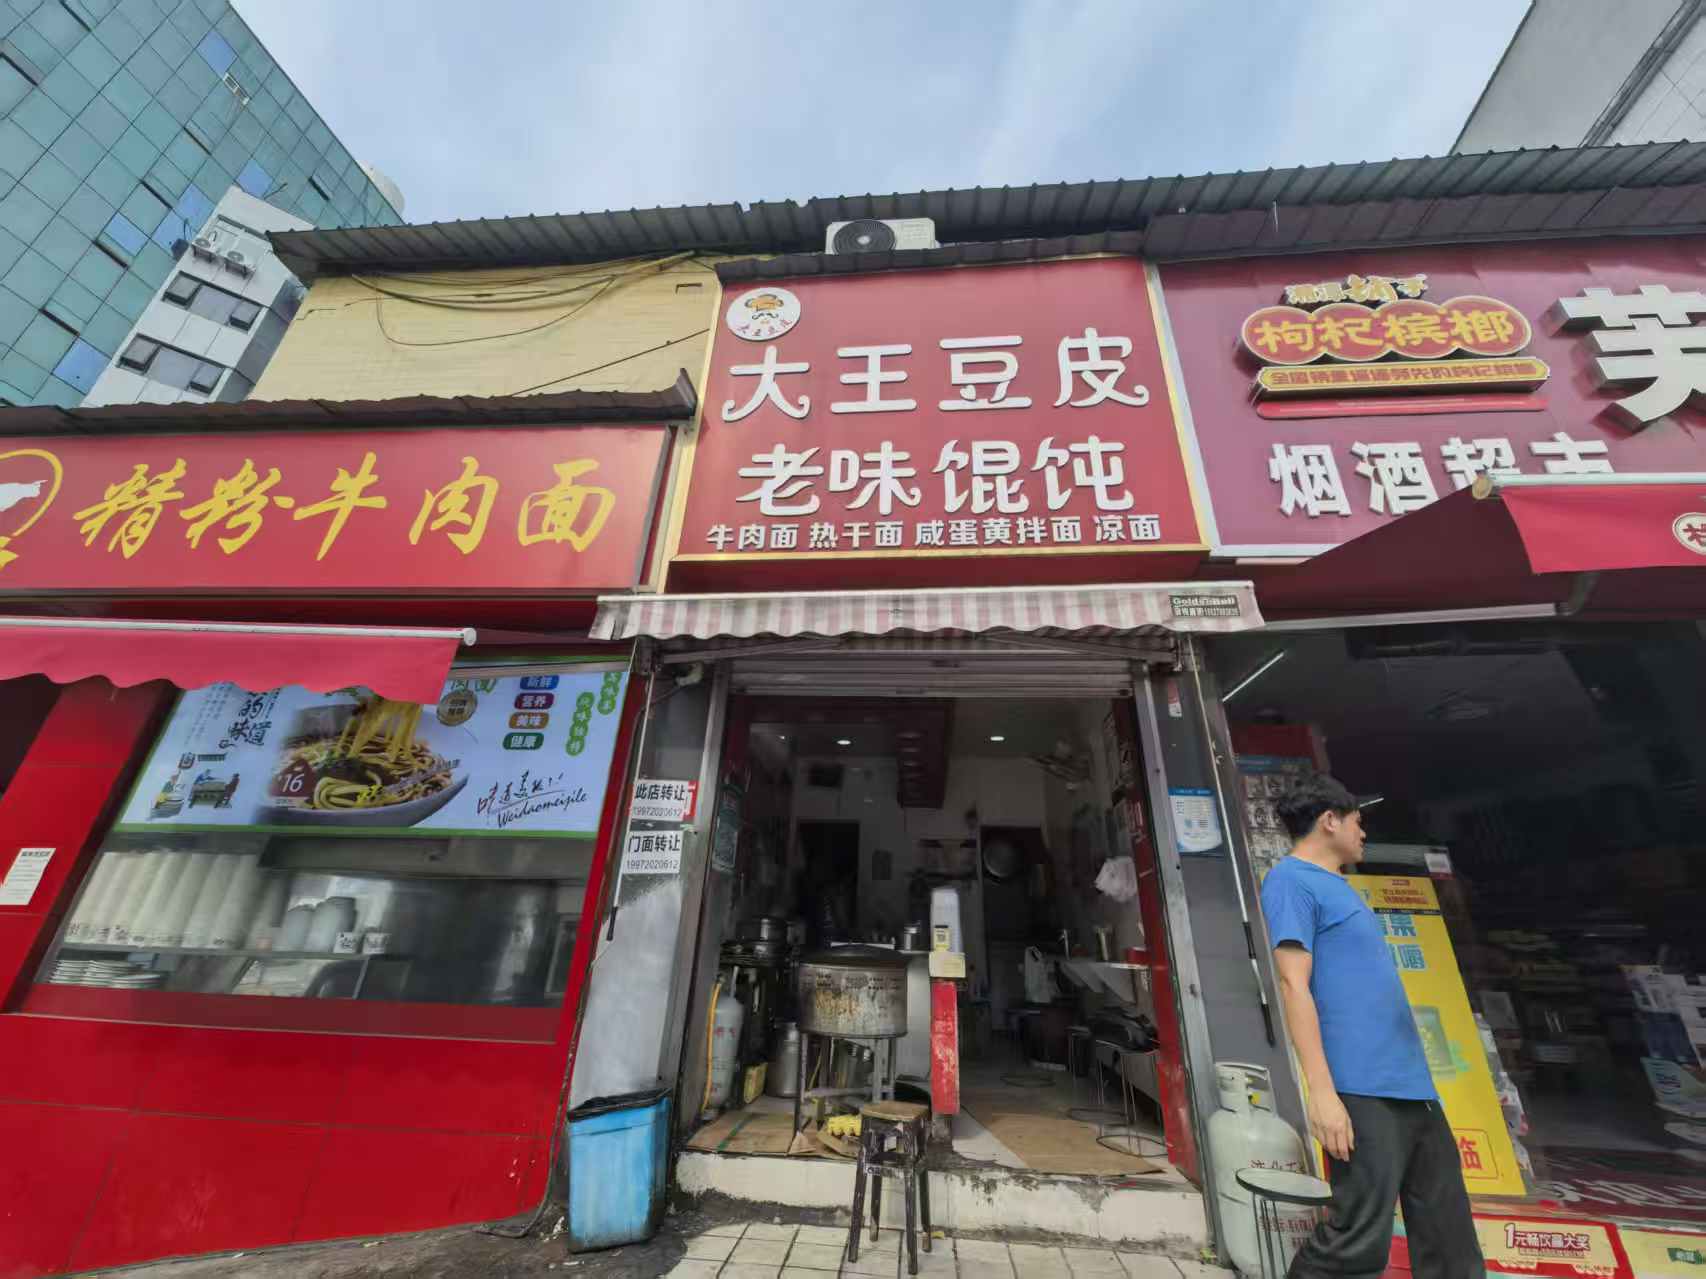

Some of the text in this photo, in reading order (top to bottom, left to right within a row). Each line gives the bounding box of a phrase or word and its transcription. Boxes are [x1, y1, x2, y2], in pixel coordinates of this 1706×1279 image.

[1256, 310, 1515, 353] 枸杞槟榔
[722, 327, 1149, 422] 大王豆皮
[736, 434, 1134, 515] 老味馄饨
[706, 514, 1160, 550] 牛肉面 热干面 咸蛋黄拌面 凉面
[635, 784, 685, 801] 此店转让
[628, 835, 681, 853] 门面转让
